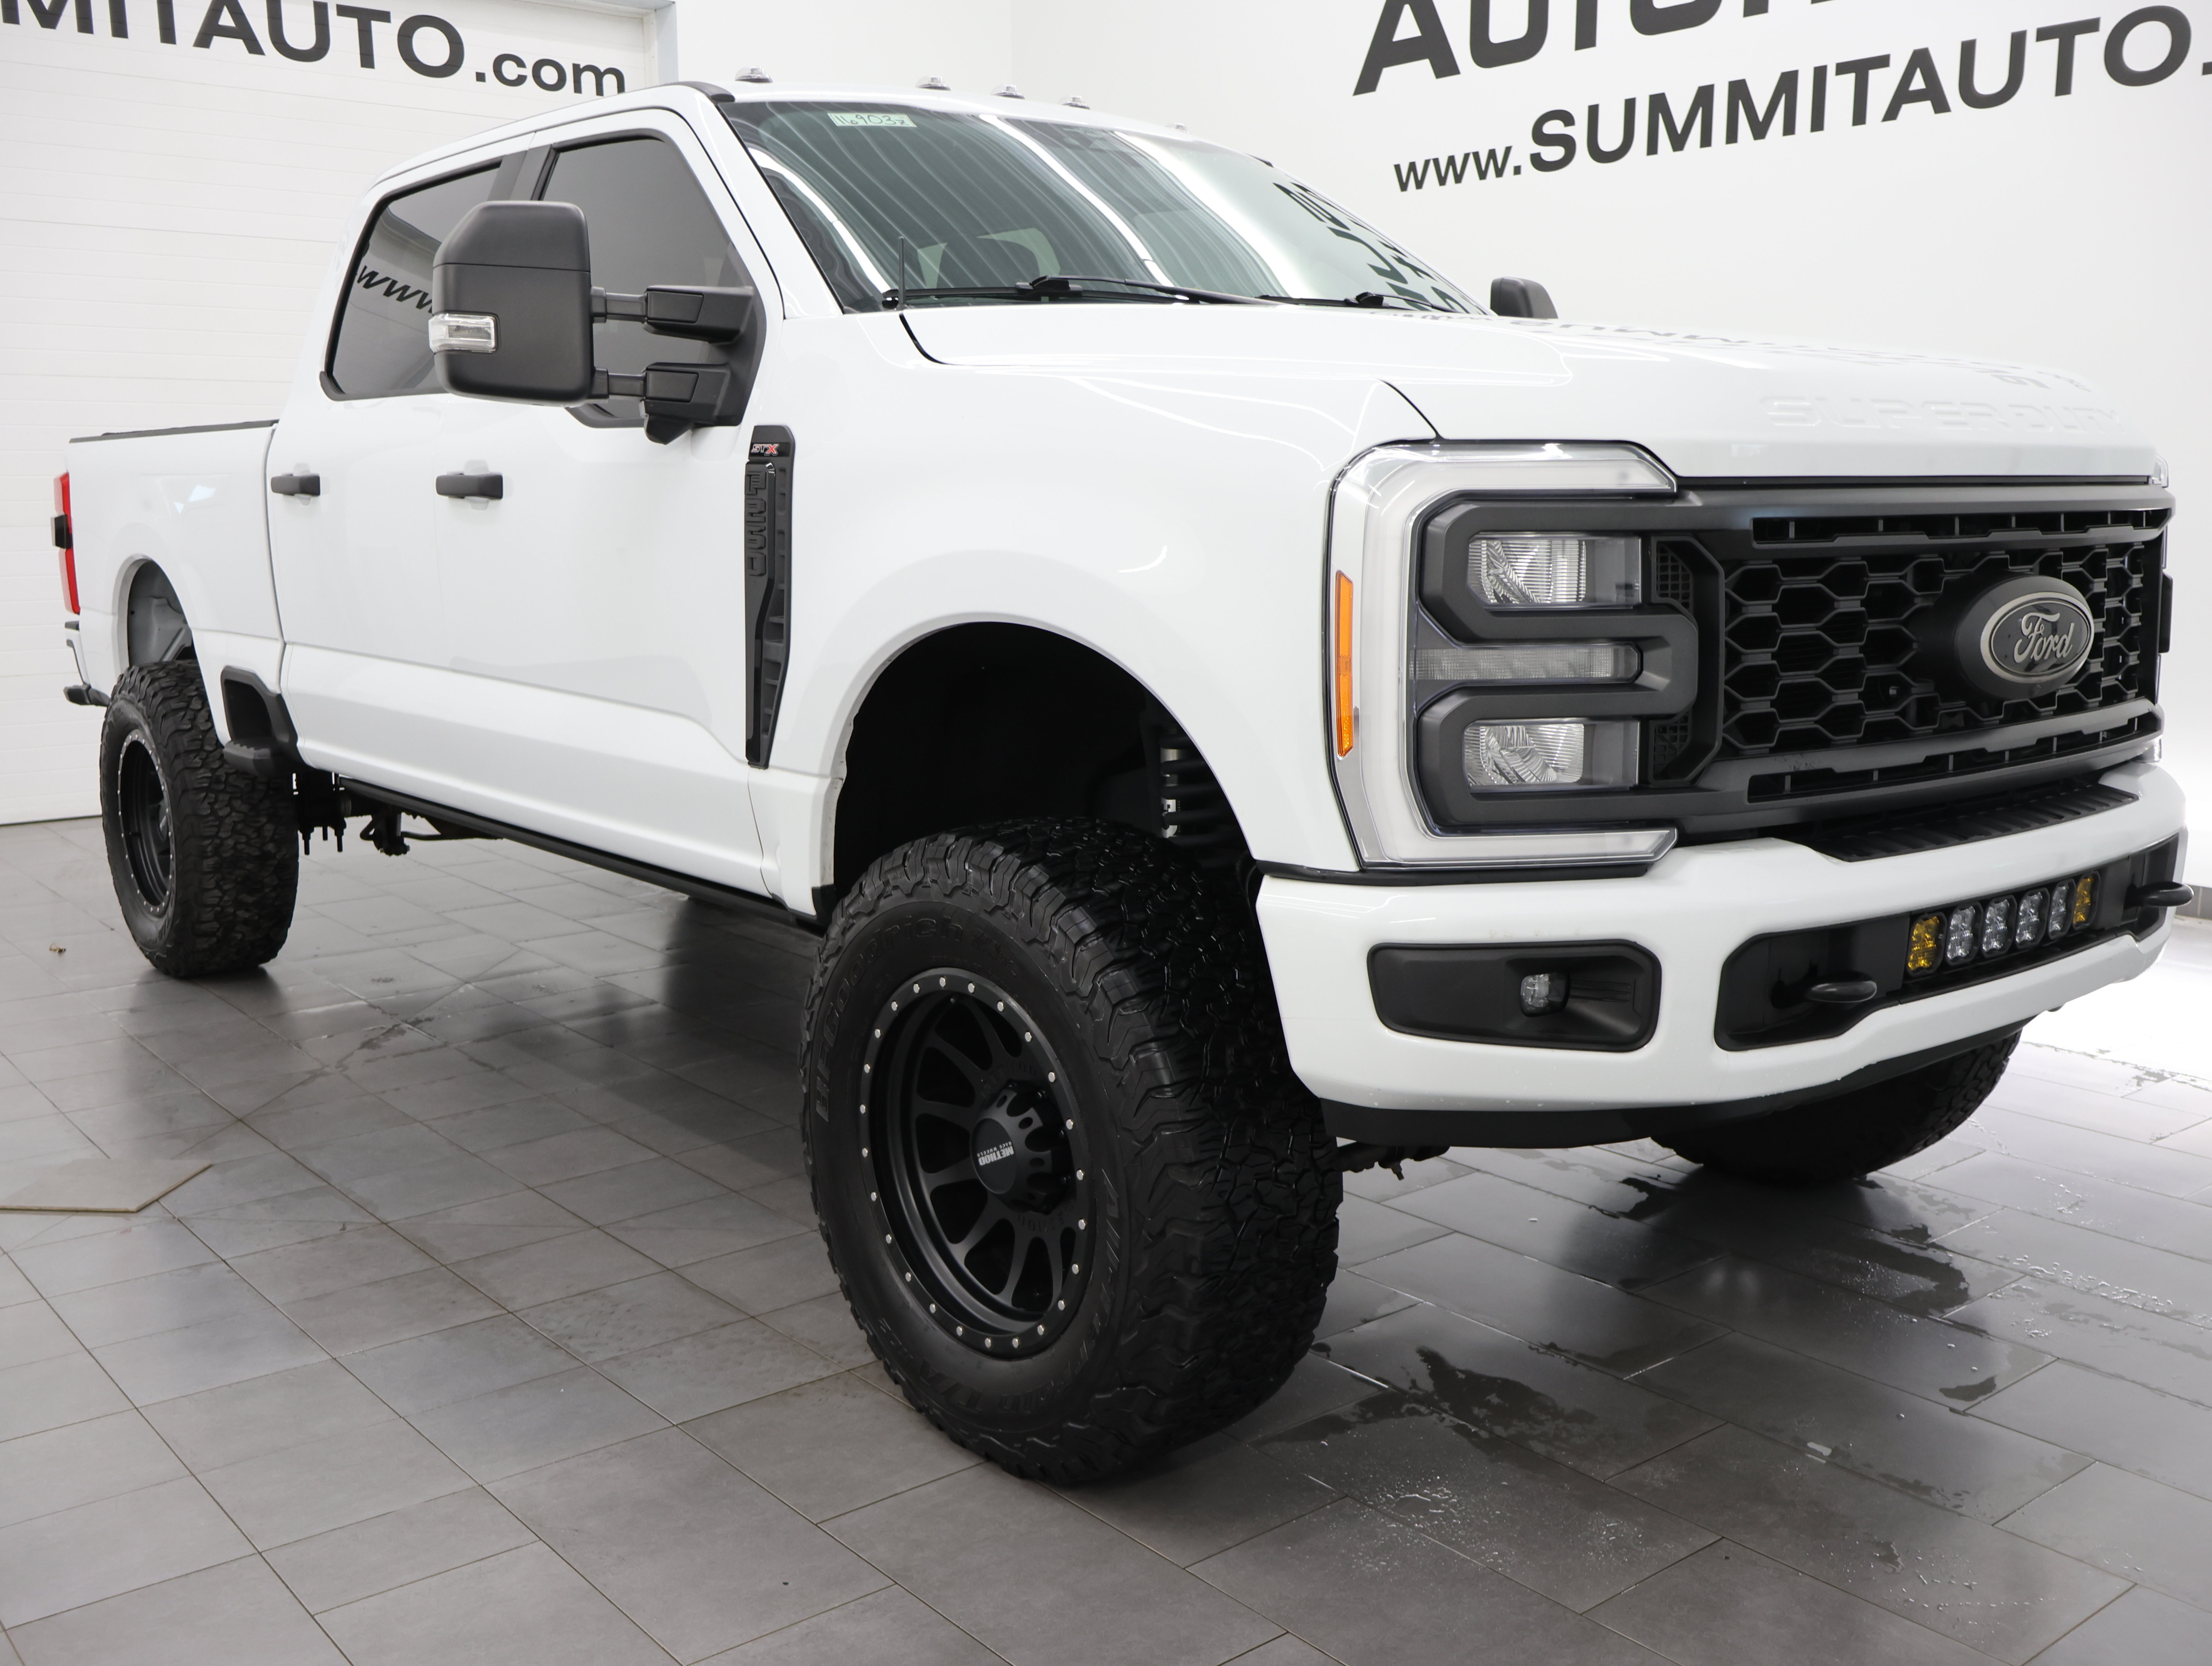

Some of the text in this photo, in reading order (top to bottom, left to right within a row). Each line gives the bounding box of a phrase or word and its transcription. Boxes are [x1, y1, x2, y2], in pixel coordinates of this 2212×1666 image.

[751, 443, 779, 456] STX
[2014, 612, 2075, 664] Ford
[816, 916, 963, 1122] BFGoodrich
[979, 1145, 1014, 1166] METHOD
